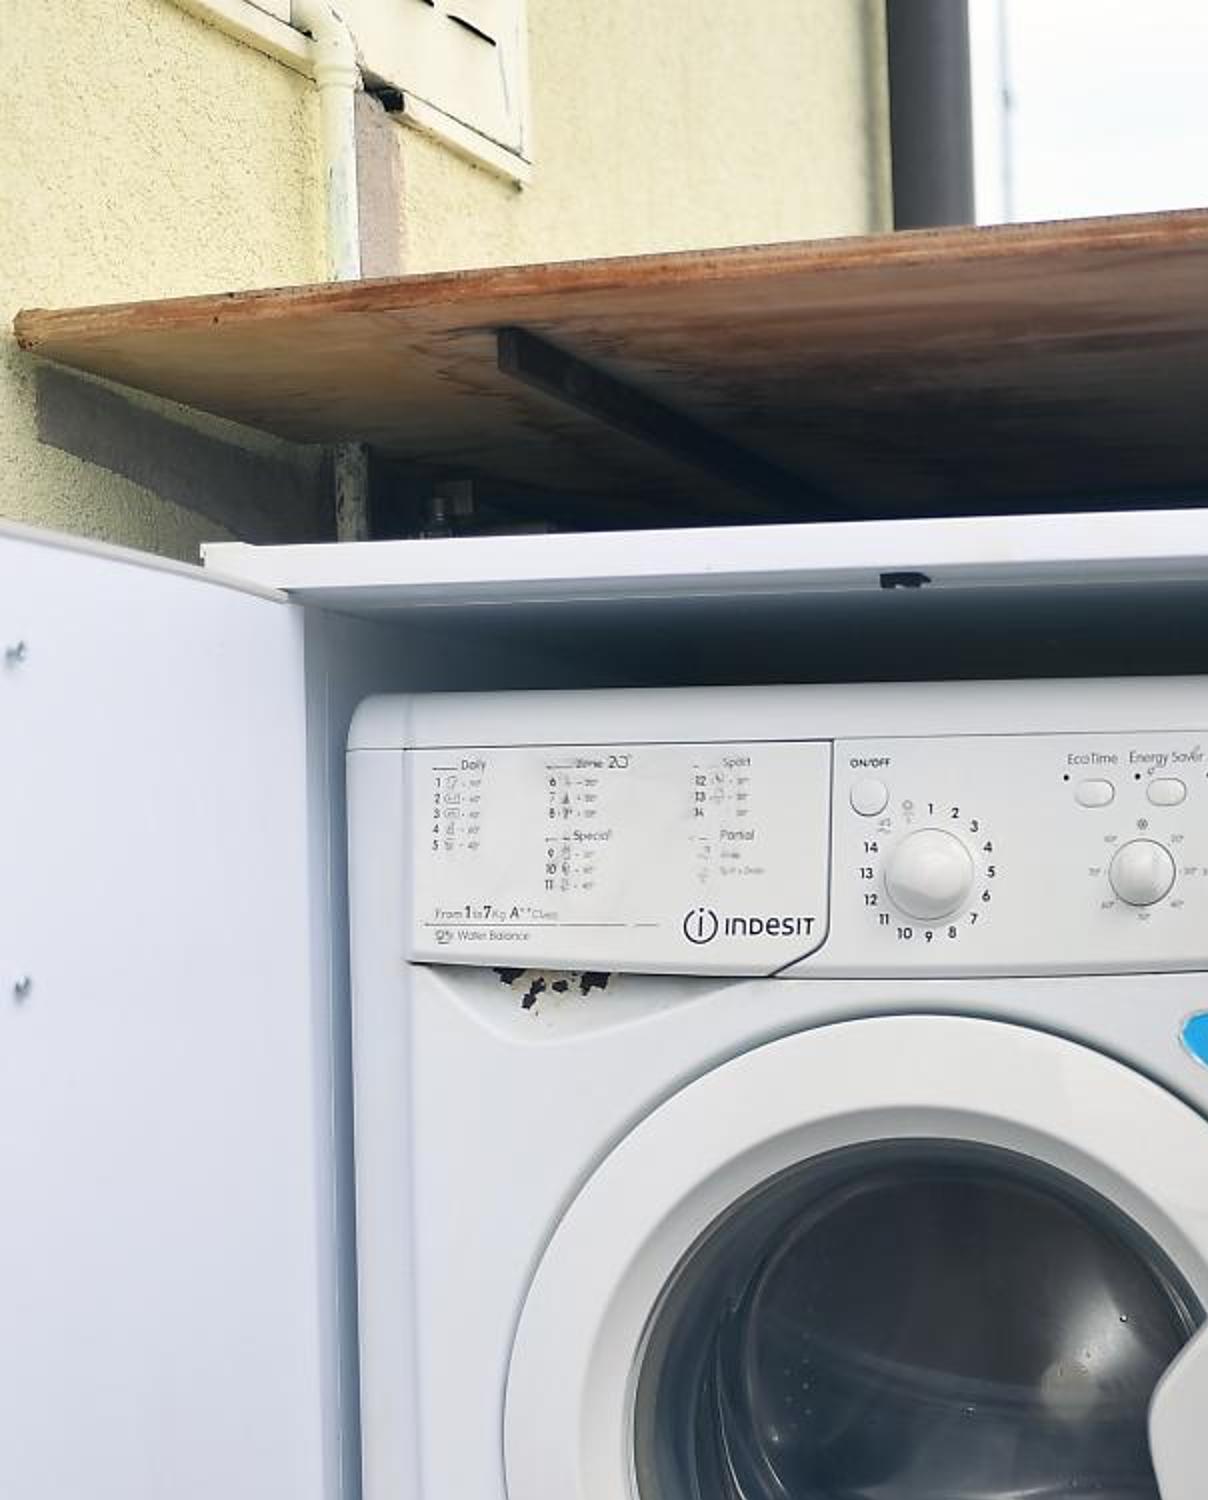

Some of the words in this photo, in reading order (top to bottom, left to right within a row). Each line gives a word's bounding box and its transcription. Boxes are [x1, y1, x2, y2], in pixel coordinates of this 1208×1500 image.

[850, 758, 890, 769] ON/OFF
[1067, 752, 1118, 765] EcoTime
[1129, 751, 1168, 767] Energy
[928, 803, 934, 815] 1
[951, 808, 960, 819] 2
[970, 821, 979, 832] 3
[864, 841, 878, 853] 14
[983, 841, 993, 852] 4
[859, 868, 874, 879] 13
[987, 866, 996, 878] 5
[864, 894, 878, 906] 12
[982, 890, 991, 902] 6
[879, 914, 889, 925] 11
[970, 914, 978, 925] 7
[457, 930, 488, 941] Water
[897, 927, 913, 939] 10
[925, 930, 933, 942] 9
[948, 927, 957, 939] 8
